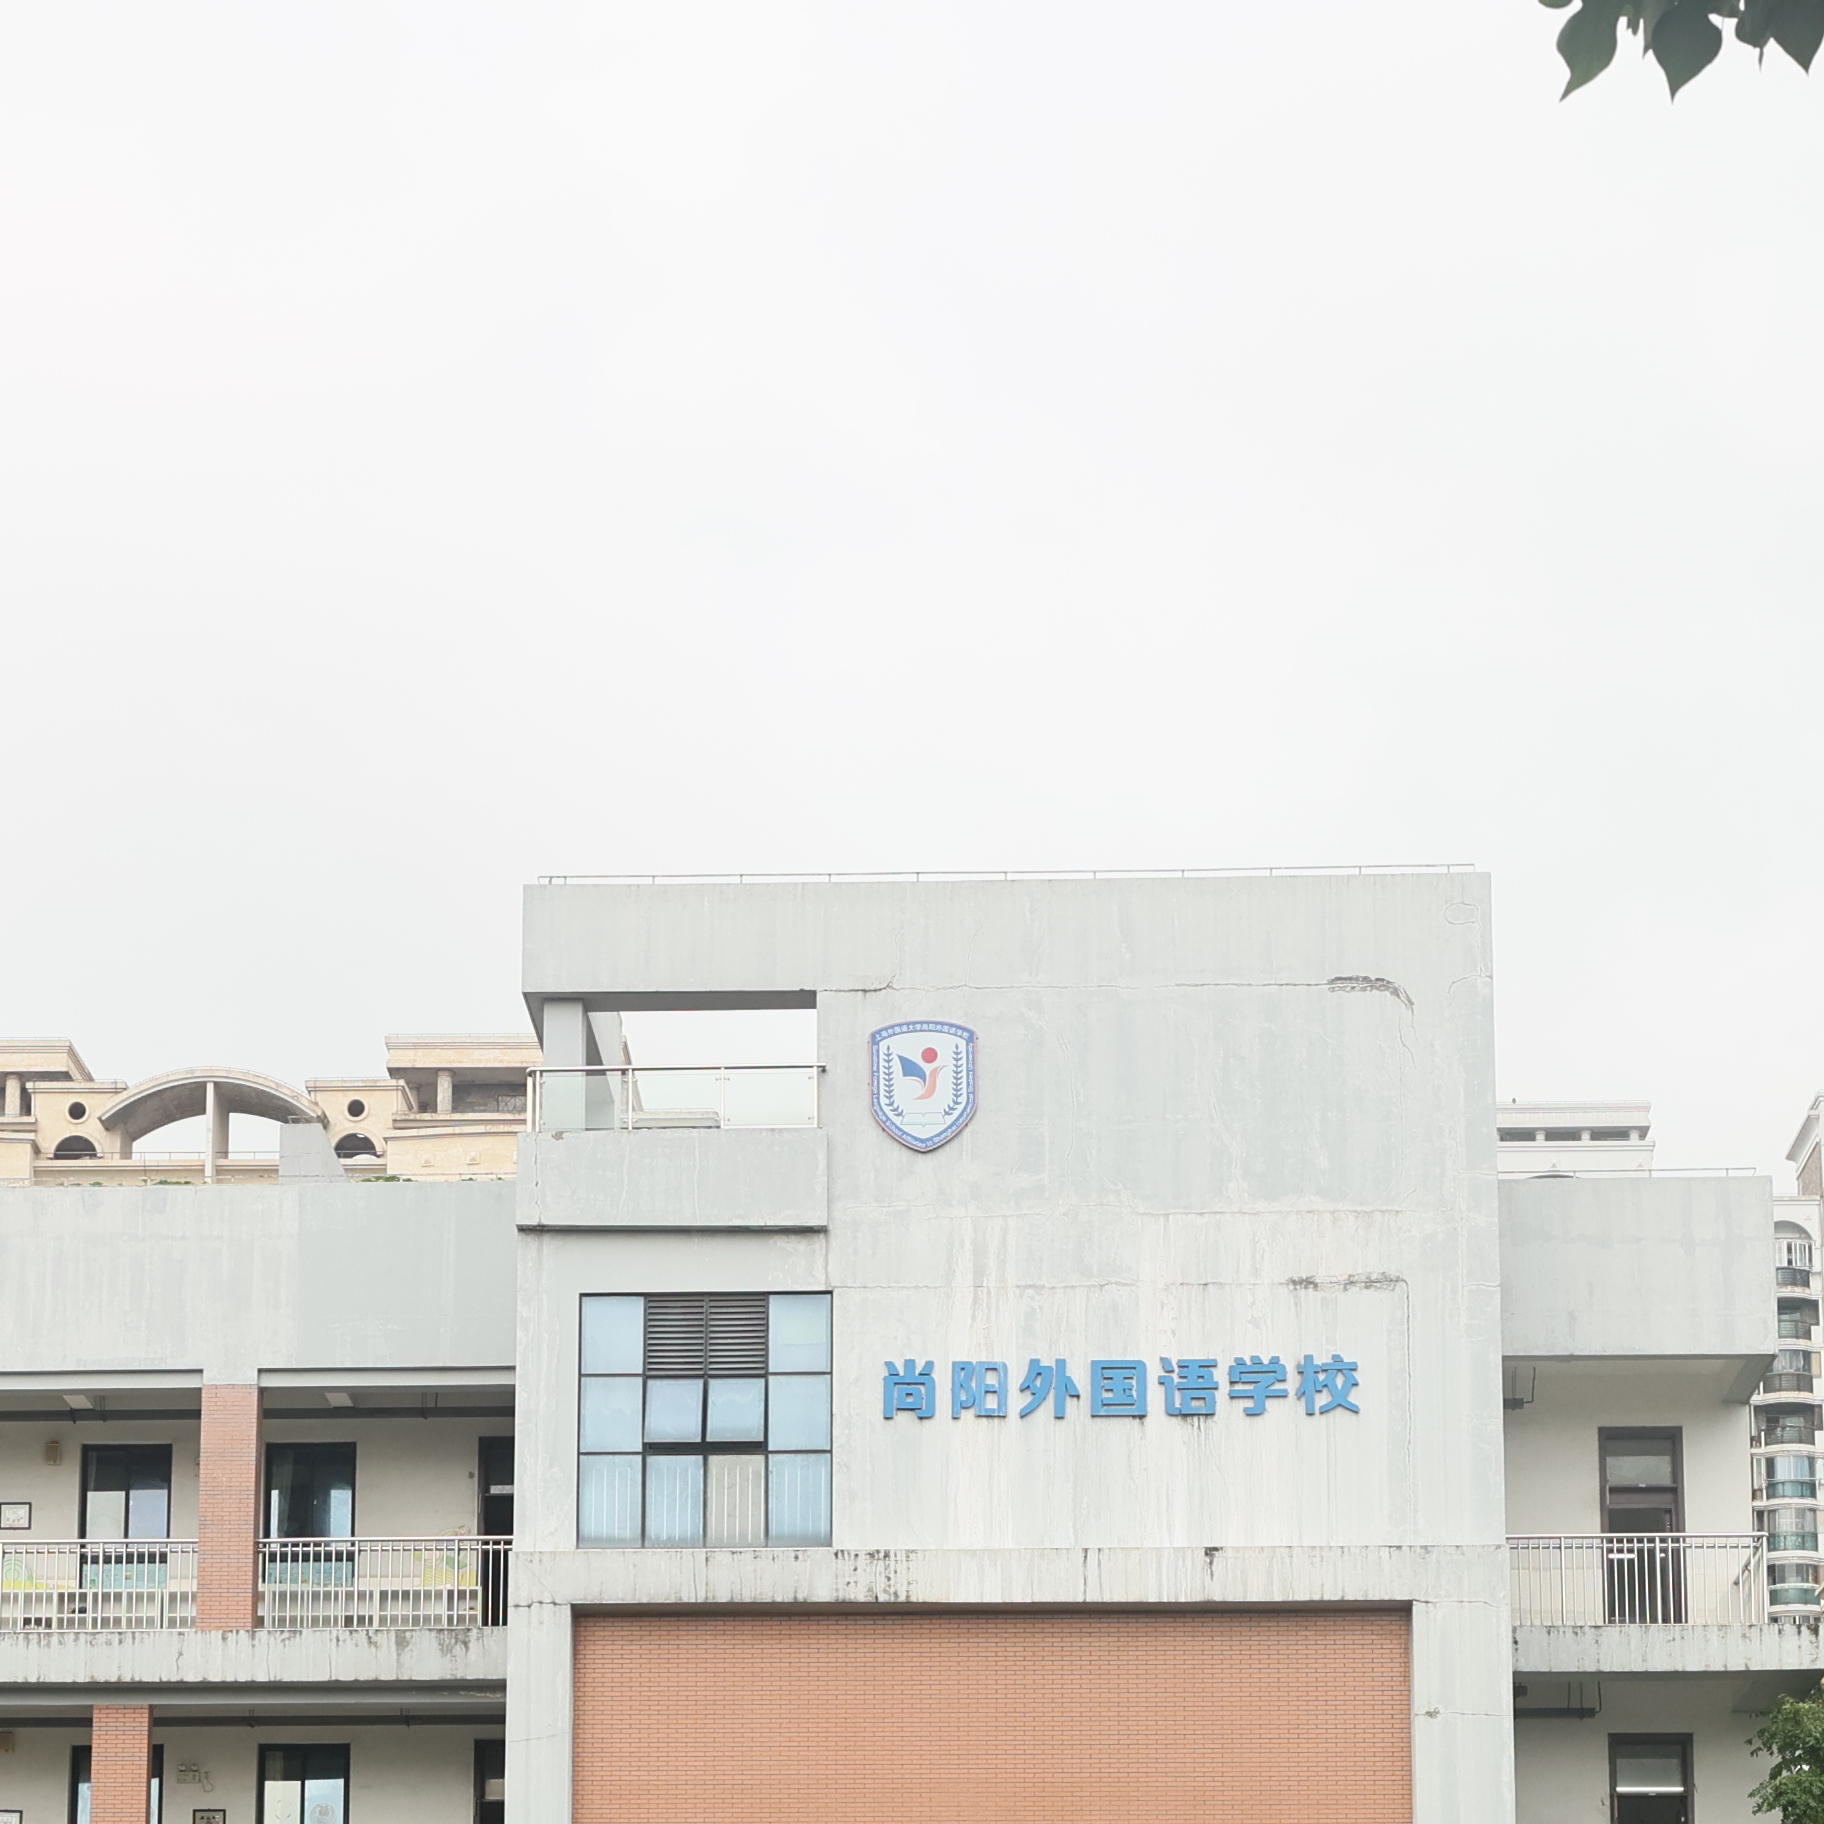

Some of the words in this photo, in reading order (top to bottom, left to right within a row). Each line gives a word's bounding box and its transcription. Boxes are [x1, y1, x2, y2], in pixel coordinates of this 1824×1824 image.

[882, 1353, 1360, 1419] 尚阳外国语学校
